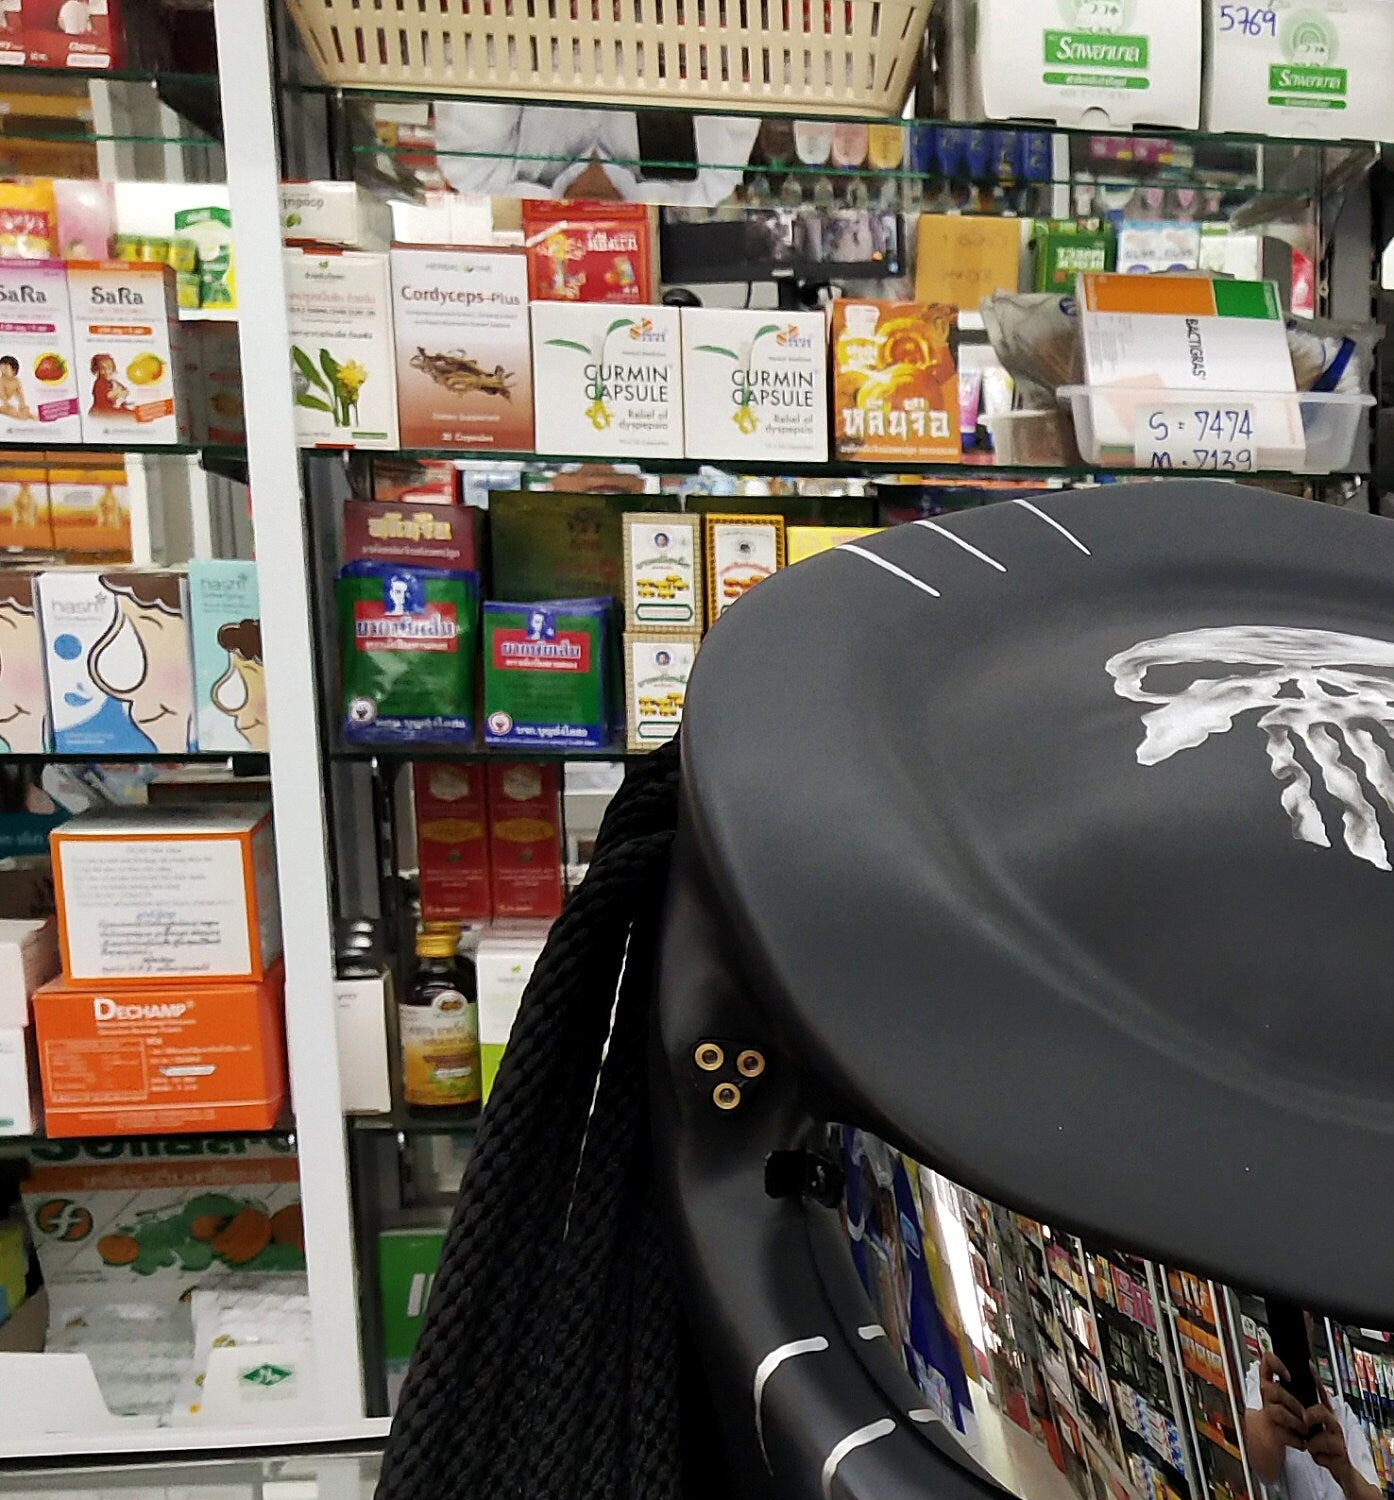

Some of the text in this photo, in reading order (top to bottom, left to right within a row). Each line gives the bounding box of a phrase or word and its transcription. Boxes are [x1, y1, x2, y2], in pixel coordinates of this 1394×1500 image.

[1220, 5, 1277, 36] 5769
[91, 286, 144, 305] SaRa
[401, 284, 521, 307] Cordyceps-Plus
[1185, 318, 1207, 378] BACTIGRAS
[585, 383, 669, 402] CAPSULE
[731, 388, 814, 408] CAPSULE
[1149, 411, 1170, 441] S
[1194, 409, 1253, 441] 7474
